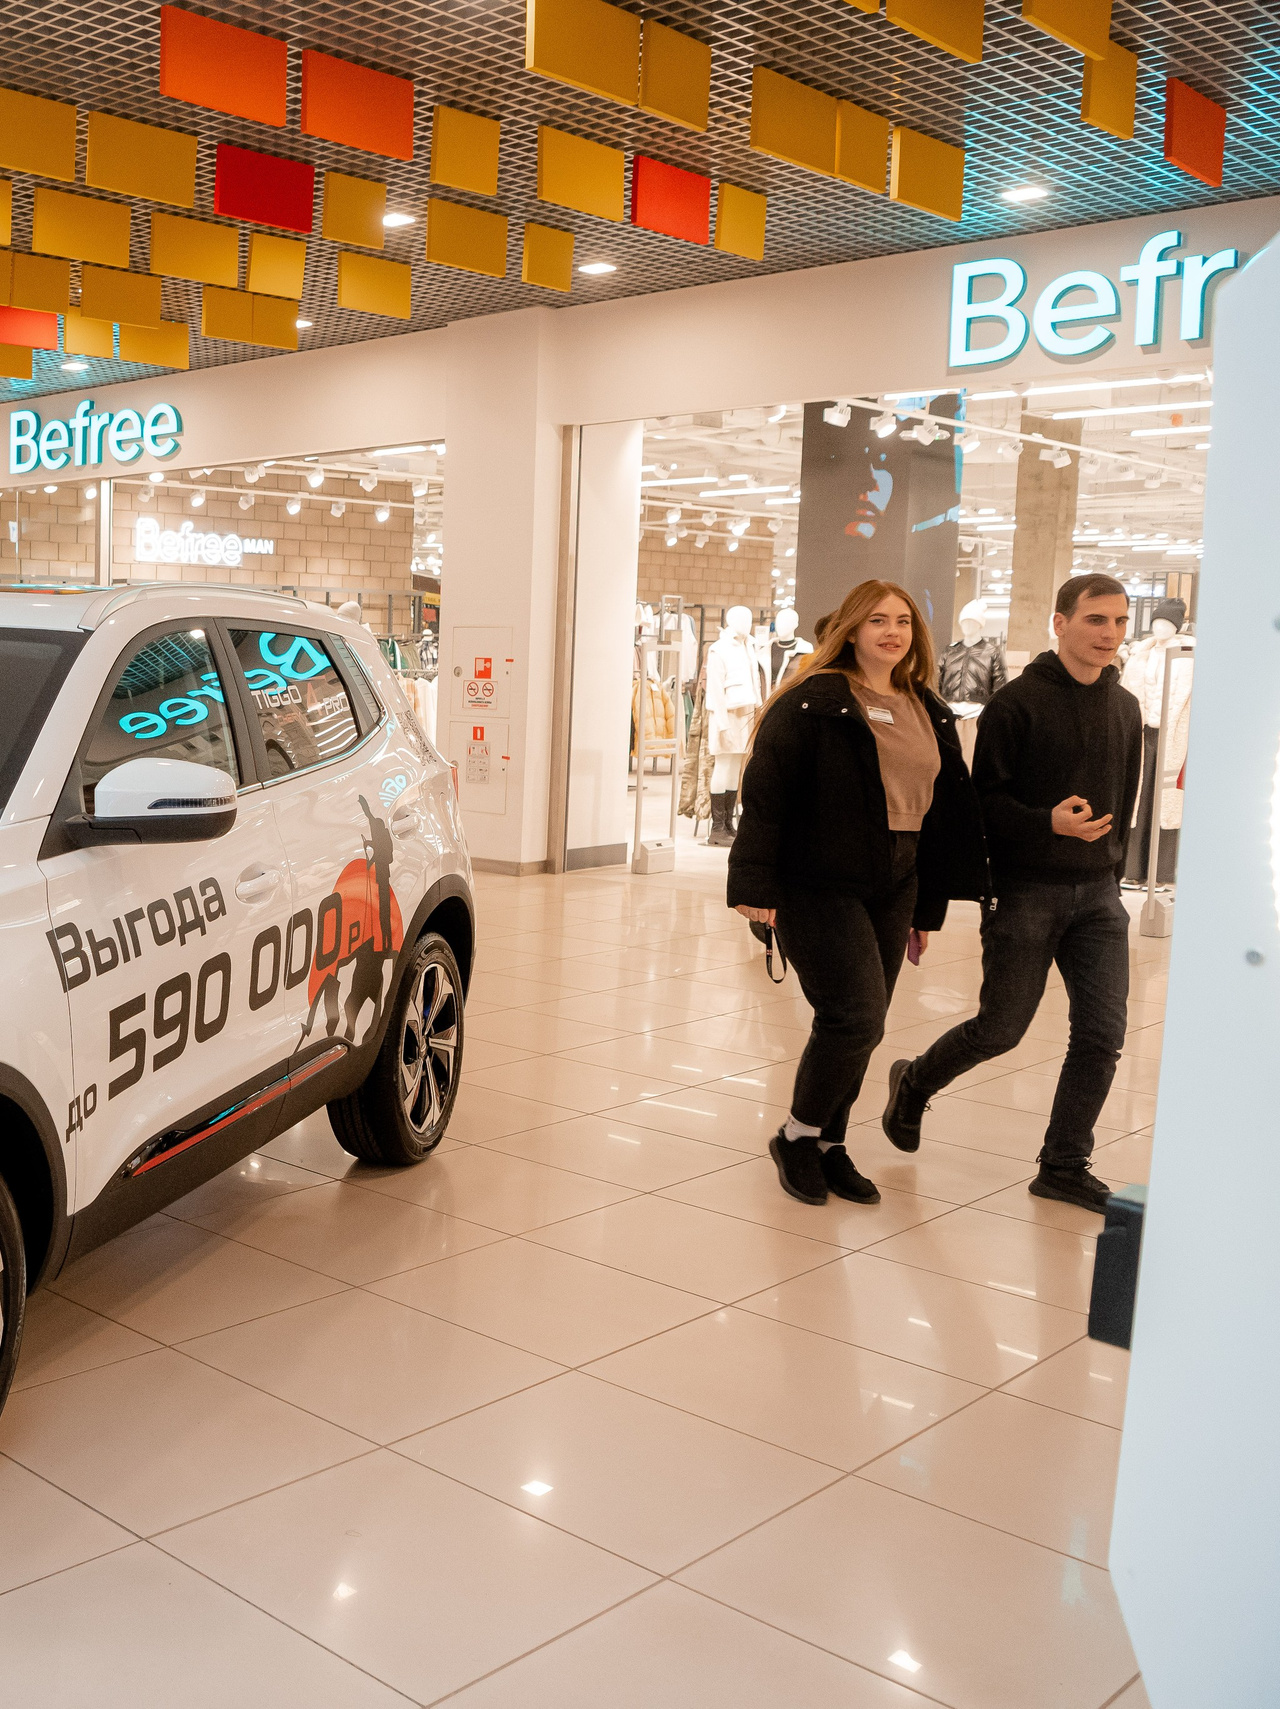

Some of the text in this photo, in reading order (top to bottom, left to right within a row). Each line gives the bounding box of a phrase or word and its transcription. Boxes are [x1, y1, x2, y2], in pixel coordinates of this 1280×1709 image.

[949, 230, 1239, 367] Befr
[9, 400, 183, 475] Befree
[134, 517, 274, 566] Befree MAN
[251, 685, 302, 709] TIGGO
[323, 695, 350, 715] PRO
[45, 876, 227, 993] Выгода
[65, 1083, 97, 1143] до
[108, 951, 232, 1101] 590
[249, 891, 343, 1011] 000
